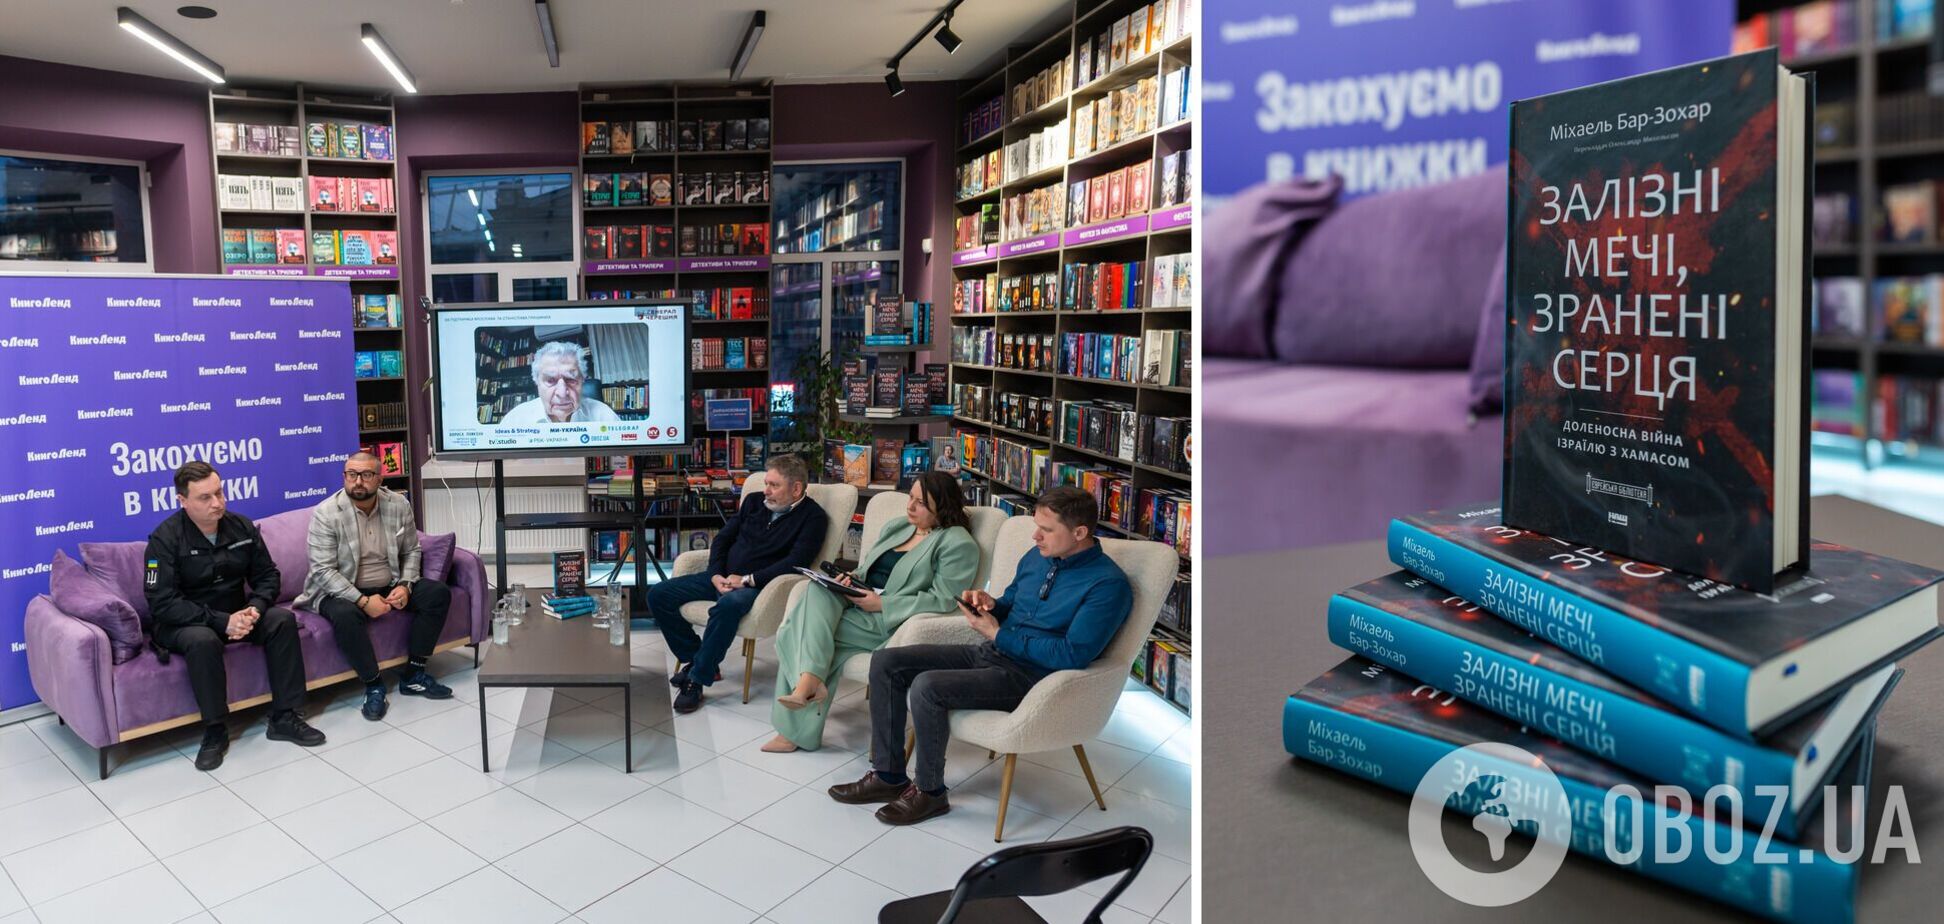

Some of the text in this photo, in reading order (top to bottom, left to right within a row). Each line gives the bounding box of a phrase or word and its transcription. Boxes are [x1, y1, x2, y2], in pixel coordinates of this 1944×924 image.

[1550, 101, 1712, 142] Міхаель Бар-Зохар
[1539, 167, 1721, 226] ЗАЛІЗНІ
[1564, 232, 1689, 287] МЕЧІ,
[9, 296, 72, 309] КнигоЛенд
[106, 296, 161, 308] КнигоЛенд
[192, 296, 242, 307] КнигоЛенд
[269, 297, 314, 307] КнигоЛенд
[1532, 293, 1728, 340] ЗРАНЕНІ
[69, 333, 127, 345] КнигоЛенд
[154, 332, 206, 343] КнигоЛенд
[230, 330, 277, 340] КнигоЛенд
[18, 373, 80, 386] КнигоЛенд
[113, 369, 168, 381] КнигоЛенд
[198, 365, 247, 376] КнигоЛенд
[1552, 348, 1698, 411] СЕРЦЯ
[77, 407, 134, 420] КнигоЛенд
[160, 402, 211, 413] КнигоЛенд
[235, 396, 282, 407] КнигоЛенд
[1562, 420, 1684, 447] ДОЛЕНОСНА ВІЙНА
[27, 448, 87, 462] КнигоЛенд
[1557, 437, 1690, 469] ІЗРАЇЛЮ З ХАМАСОМ
[35, 520, 94, 537] КнигоЛенд
[1402, 536, 1436, 561] Міхаель
[1402, 552, 1445, 584] Бар-Зохар
[1483, 568, 1596, 640] ЗАЛІЗНІ МЕЧІ,
[1349, 613, 1395, 643] Міхаель
[1479, 589, 1605, 666] ЗРАНЕНІ СЕРЦЯ
[1349, 631, 1407, 667] Бар-Зохар
[1460, 650, 1540, 700] ЗАЛІЗНІ
[1545, 682, 1607, 731] МЕЧІ,
[1453, 674, 1536, 725] ЗРАНЕНІ
[1542, 711, 1617, 759] СЕРЦЯ
[1308, 719, 1367, 752] Міхаель
[1307, 739, 1383, 778] Бар-Зохар
